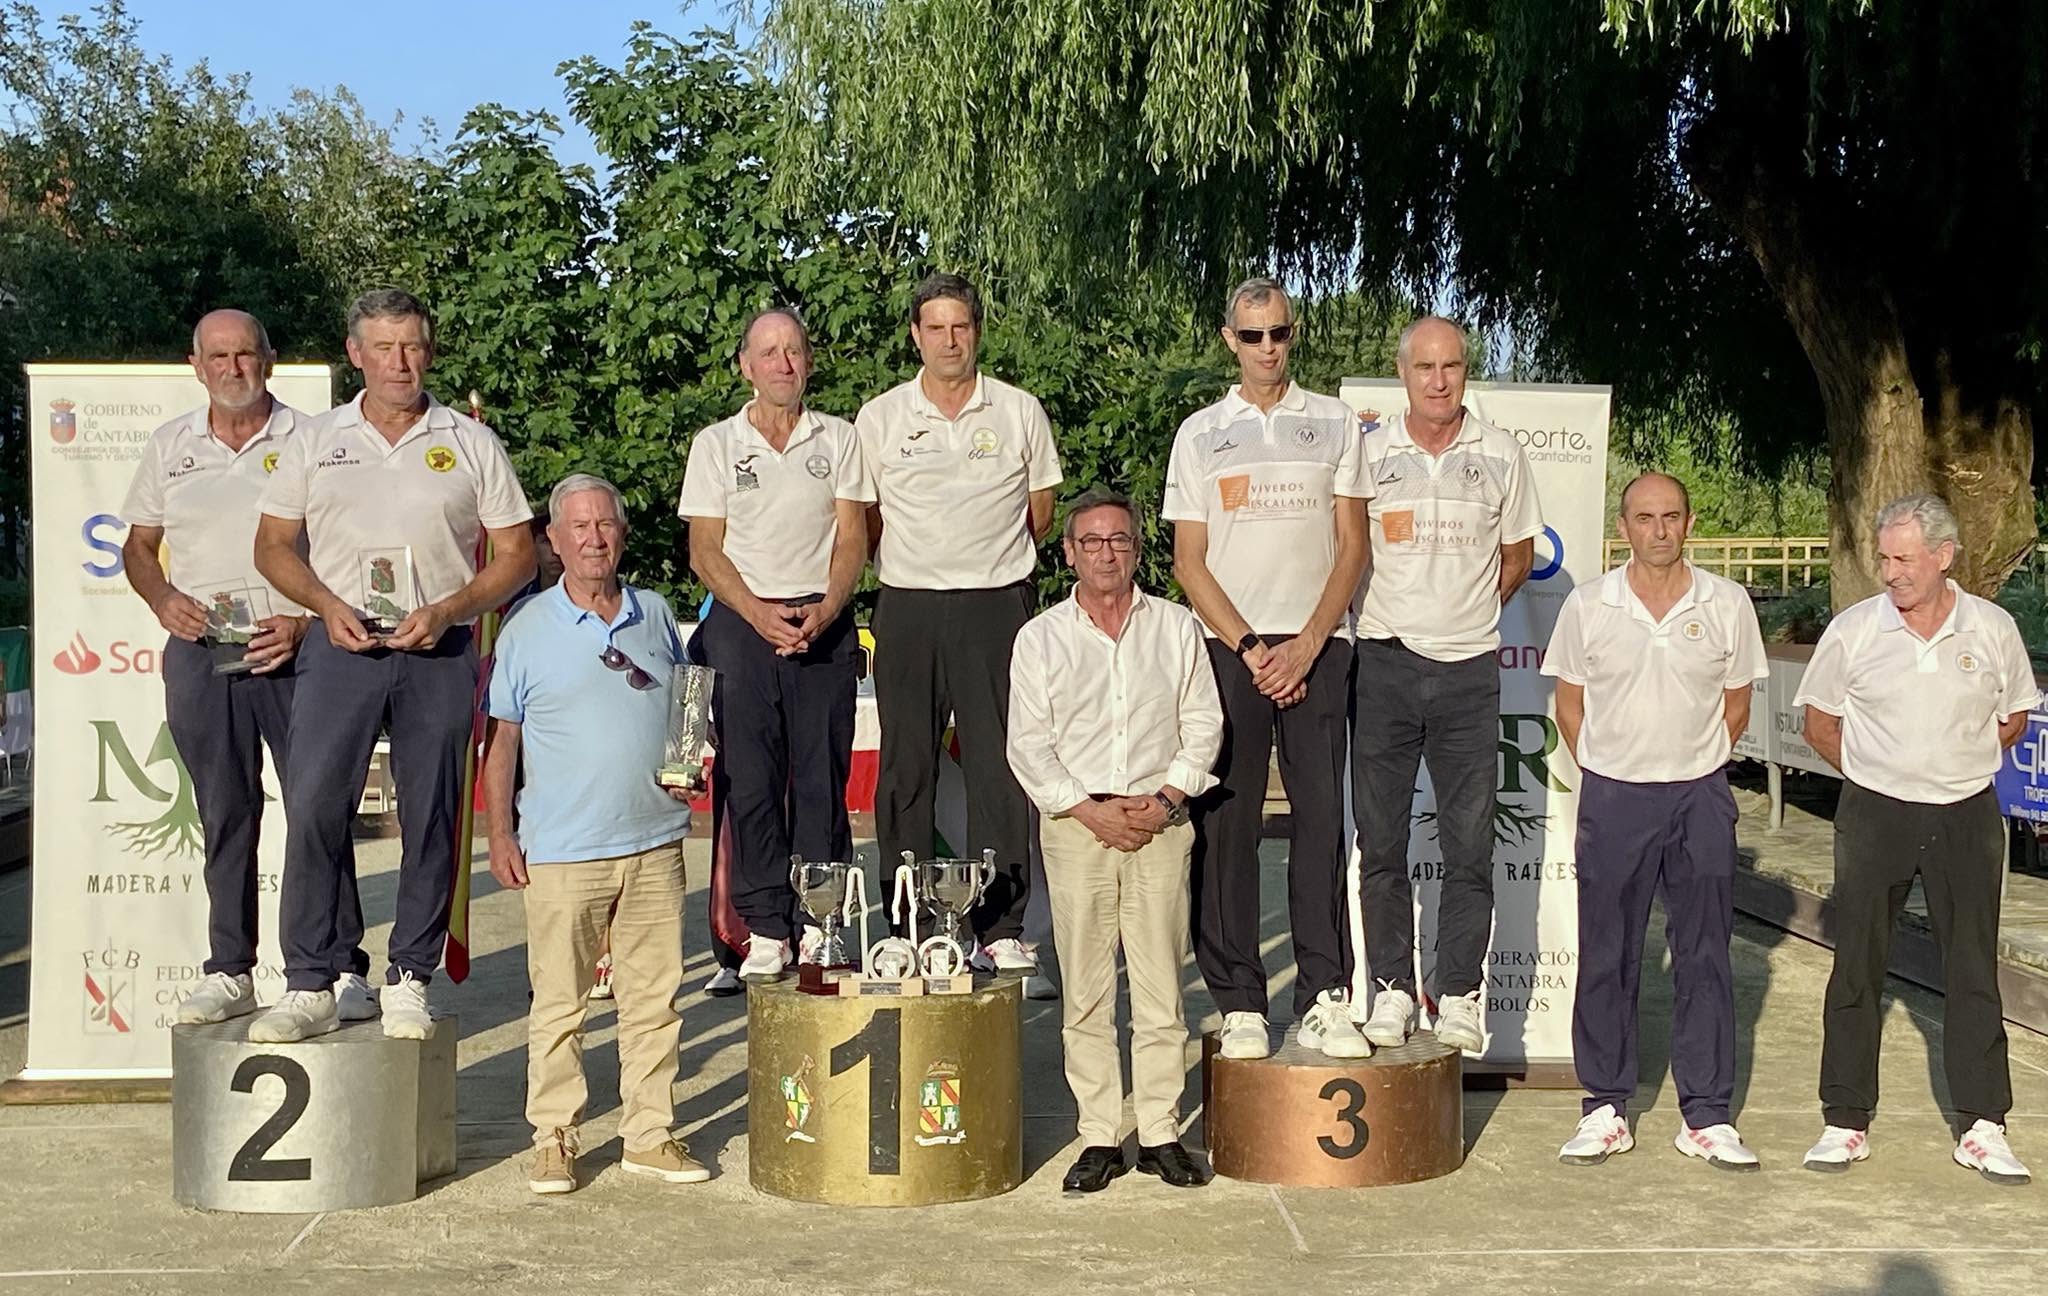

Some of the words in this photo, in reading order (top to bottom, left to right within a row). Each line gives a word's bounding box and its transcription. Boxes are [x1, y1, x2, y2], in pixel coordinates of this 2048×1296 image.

[83, 403, 162, 417] GOBIERNO
[83, 417, 98, 430] de
[83, 430, 152, 443] CANTABR
[1528, 452, 1592, 464] cantabria
[1251, 481, 1304, 493] VIVEROS
[1251, 499, 1318, 510] ESCALANTE
[110, 641, 164, 674] Sa
[1505, 857, 1578, 881] RAÍCES
[87, 875, 171, 893] MADERA
[182, 874, 192, 893] Y
[1487, 948, 1577, 966] DERACIÓ
[1486, 975, 1567, 989] NTABRA
[1488, 997, 1550, 1012] BOLOS
[830, 1008, 901, 1175] 1
[228, 1054, 311, 1181] 2
[1316, 1078, 1369, 1159] 3
